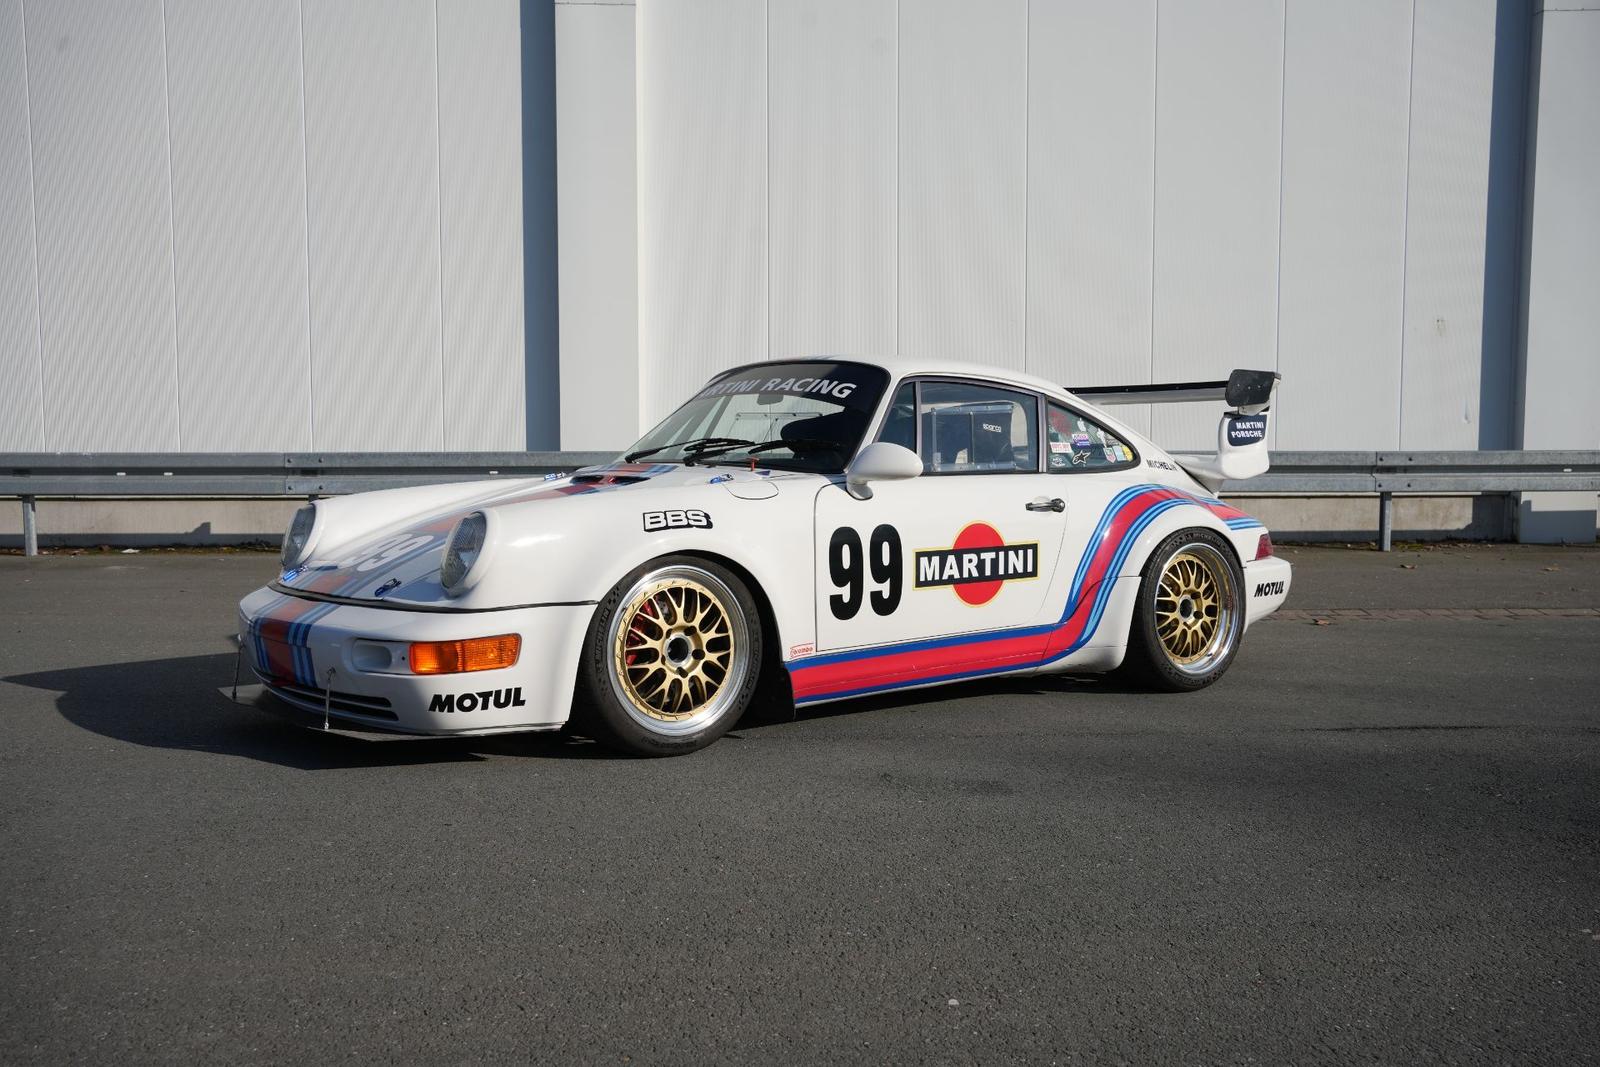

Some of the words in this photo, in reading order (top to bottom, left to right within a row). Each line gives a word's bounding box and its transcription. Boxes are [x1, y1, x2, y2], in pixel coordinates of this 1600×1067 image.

[760, 378, 857, 398] RACING
[1231, 430, 1263, 438] PORSCHE
[1236, 421, 1265, 429] MARTINI
[643, 509, 714, 532] BBS
[829, 523, 903, 620] 99
[919, 548, 1033, 582] MARTINI
[1254, 581, 1284, 597] MOTUL
[428, 686, 526, 713] MOTUL
